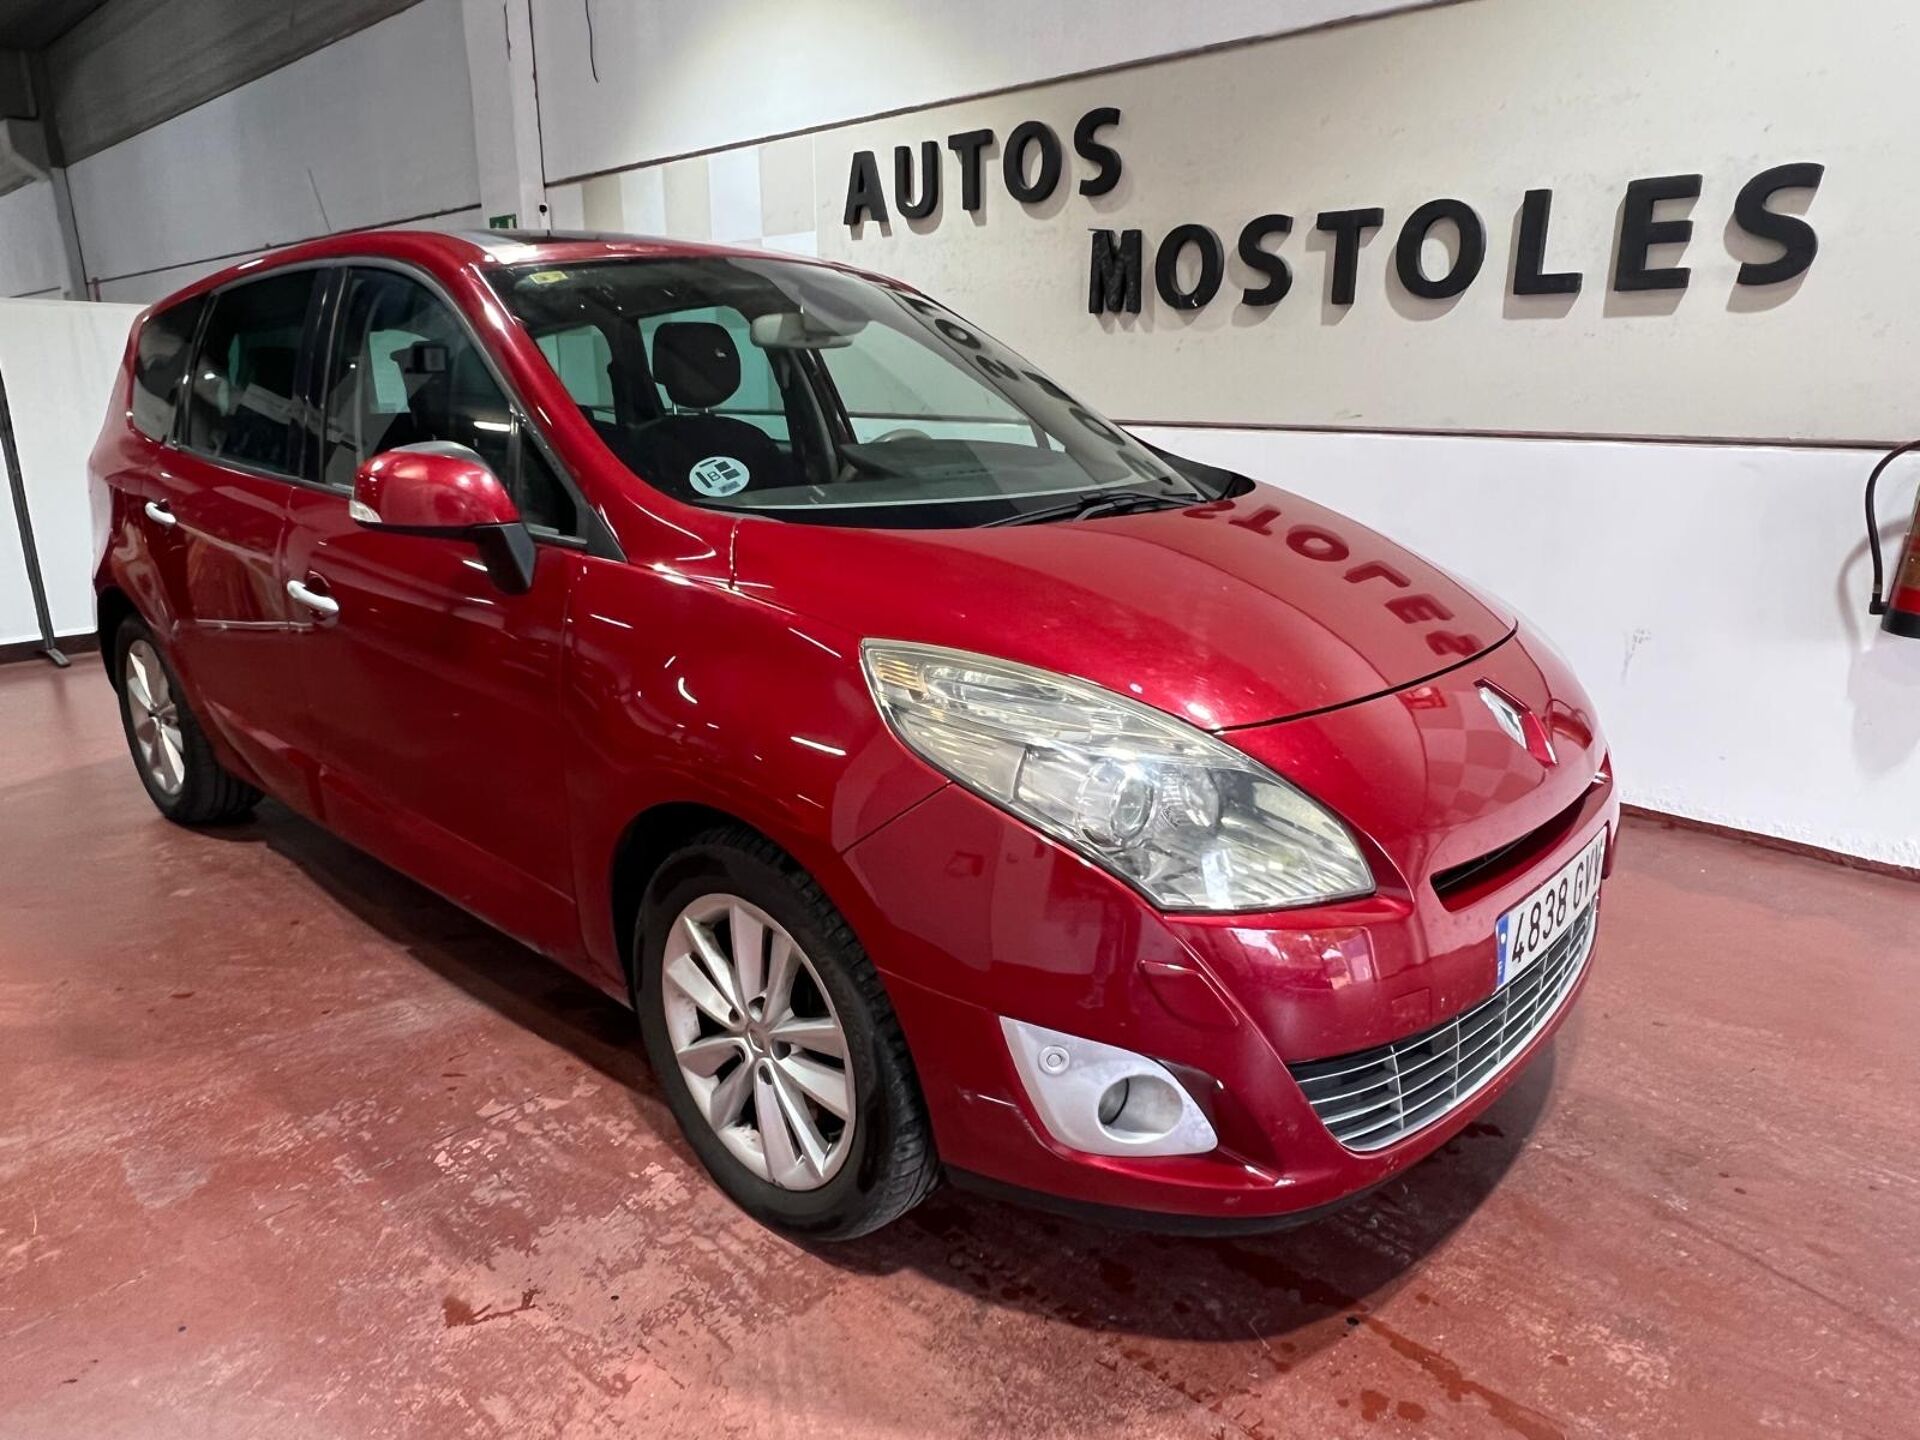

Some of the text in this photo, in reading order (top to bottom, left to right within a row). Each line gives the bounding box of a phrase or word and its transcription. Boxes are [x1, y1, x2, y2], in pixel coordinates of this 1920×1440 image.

[843, 107, 1122, 226] AUTOS
[1088, 162, 1825, 315] MOSTOLES
[1511, 877, 1568, 964] 4838
